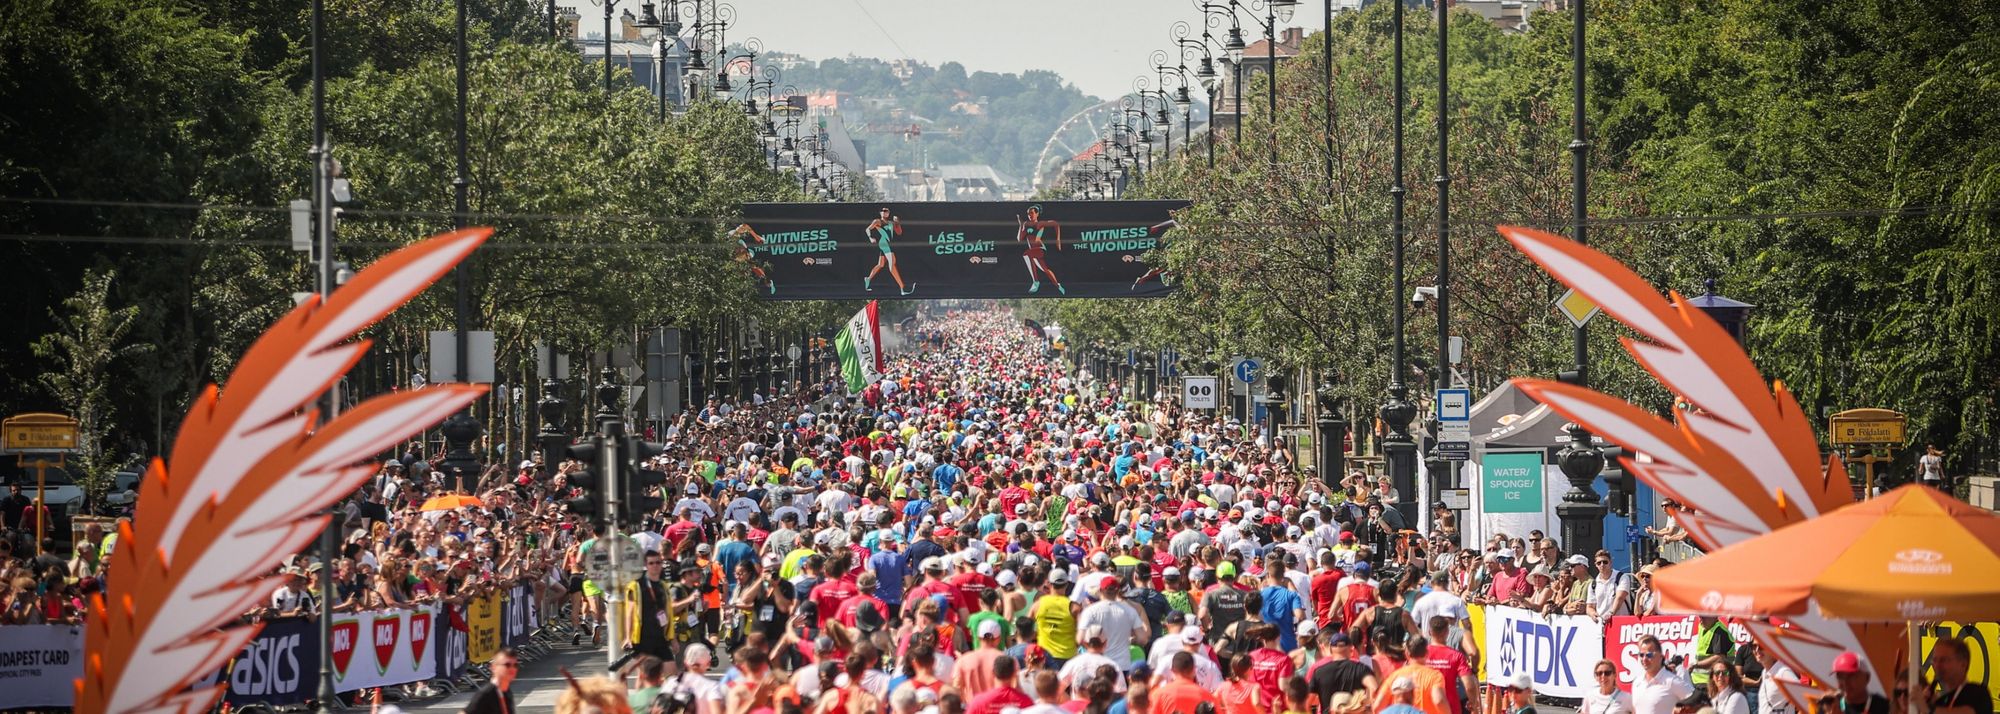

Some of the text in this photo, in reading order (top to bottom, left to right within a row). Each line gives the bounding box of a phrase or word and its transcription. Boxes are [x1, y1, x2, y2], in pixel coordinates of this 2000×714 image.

[762, 229, 829, 244] WITNESS
[928, 231, 964, 245] LÁSS
[1081, 227, 1148, 242] WITNESS
[770, 240, 838, 256] WONDER
[935, 239, 995, 255] CSODÁT!
[1089, 237, 1157, 253] WONDER
[1493, 468, 1530, 477] WATER/
[1490, 480, 1535, 488] SPONGE/
[1504, 492, 1521, 500] ICE
[376, 623, 394, 646] MOL
[412, 619, 425, 642] MOL
[1620, 615, 1695, 644] nemzeti
[333, 628, 350, 653] MOL
[43, 650, 69, 665] CARD
[1516, 619, 1578, 687] TDK
[1619, 634, 1699, 683] Sort
[231, 633, 300, 695] asics
